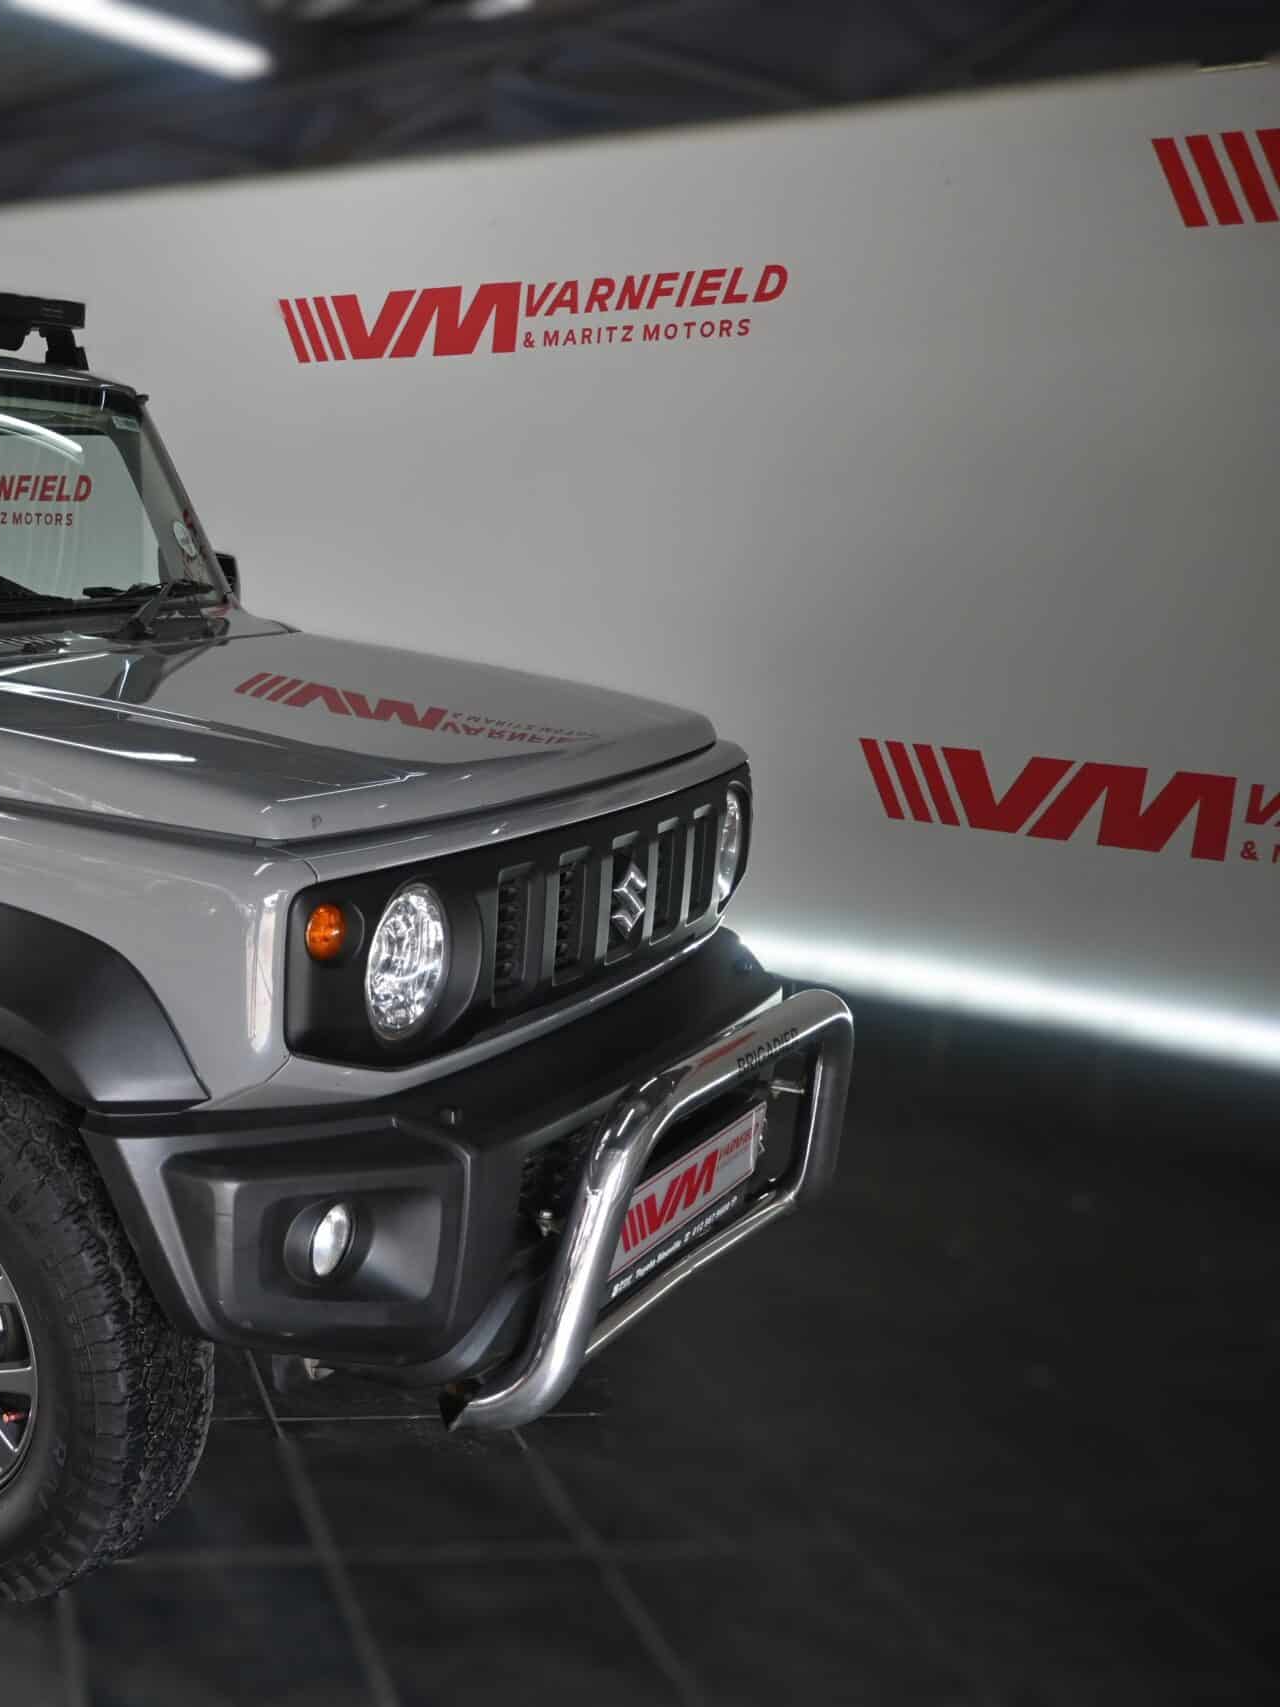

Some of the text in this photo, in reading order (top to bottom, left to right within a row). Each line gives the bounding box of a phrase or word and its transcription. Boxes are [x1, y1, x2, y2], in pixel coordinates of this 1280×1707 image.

[330, 281, 521, 360] VM
[522, 264, 788, 318] VARNFIELD
[522, 318, 752, 349] & MARITZ MOTORS
[12, 512, 74, 526] MOTORS
[941, 746, 1238, 862] VM
[643, 1149, 720, 1234] VM
